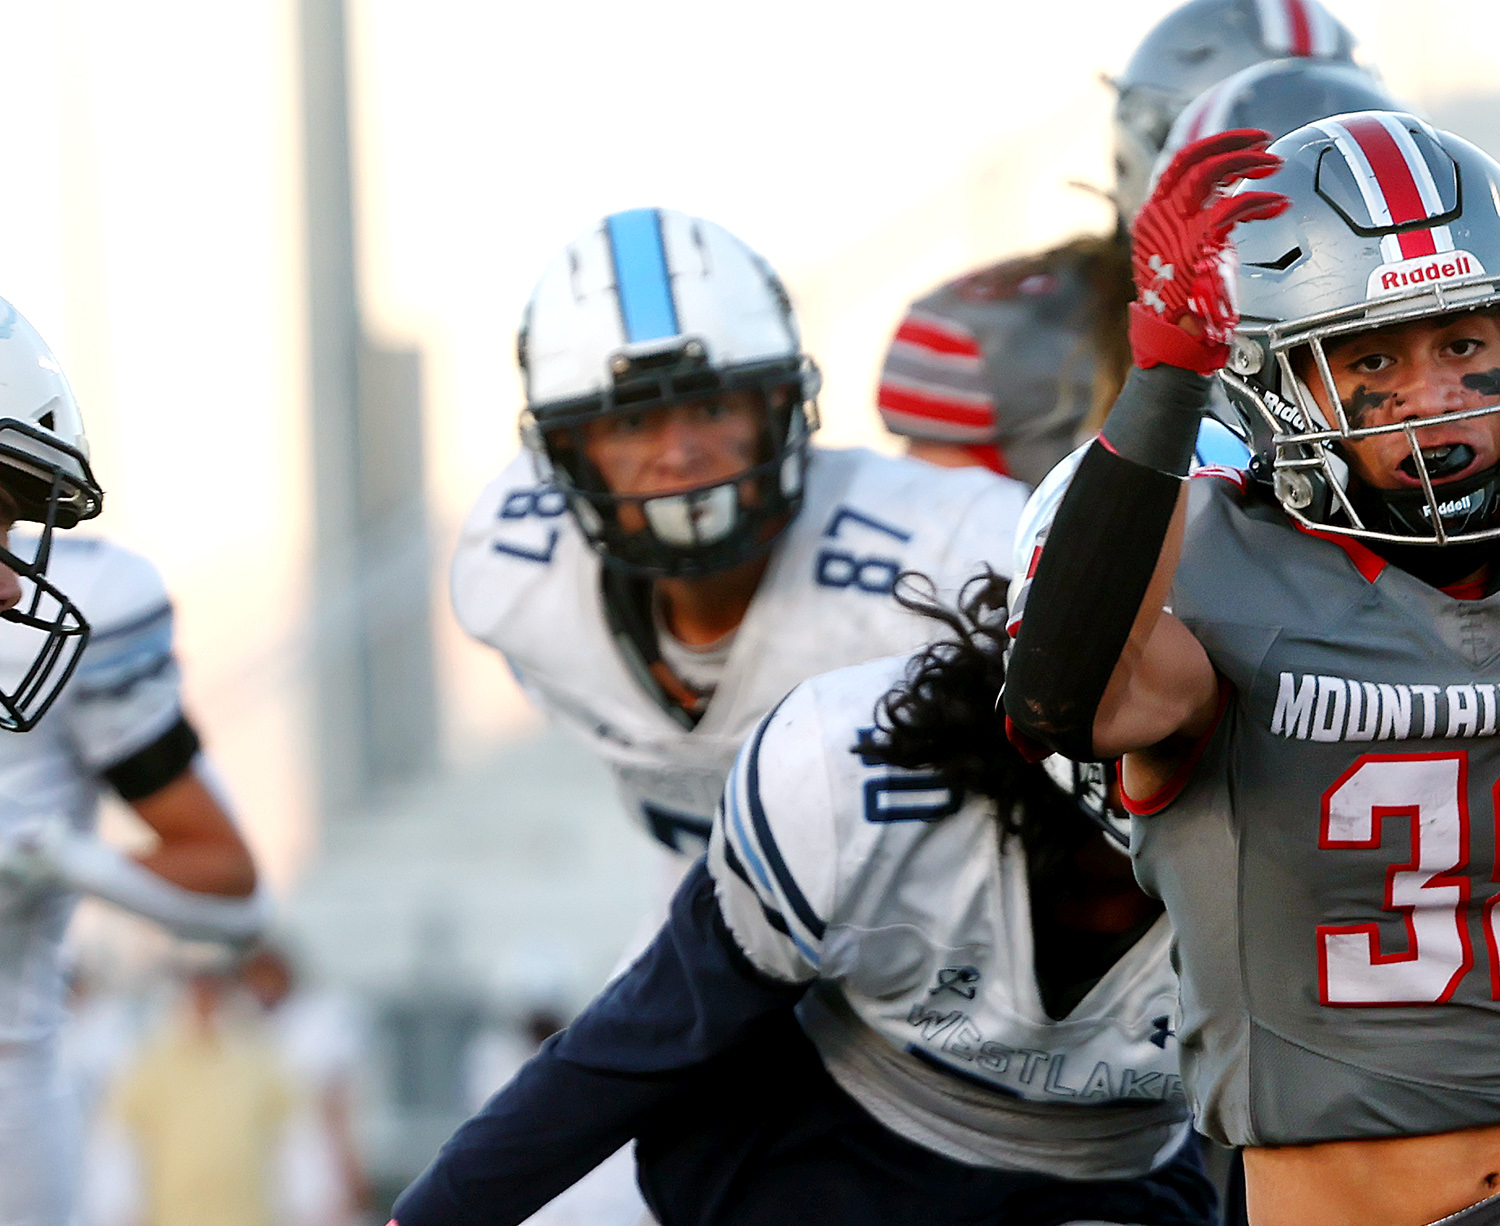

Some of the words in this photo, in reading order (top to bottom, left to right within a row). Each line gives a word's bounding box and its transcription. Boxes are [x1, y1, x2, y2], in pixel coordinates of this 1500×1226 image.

[1381, 257, 1471, 290] Riddell
[495, 485, 567, 564] 87
[1423, 496, 1471, 517] Rddell
[817, 506, 912, 595] 87
